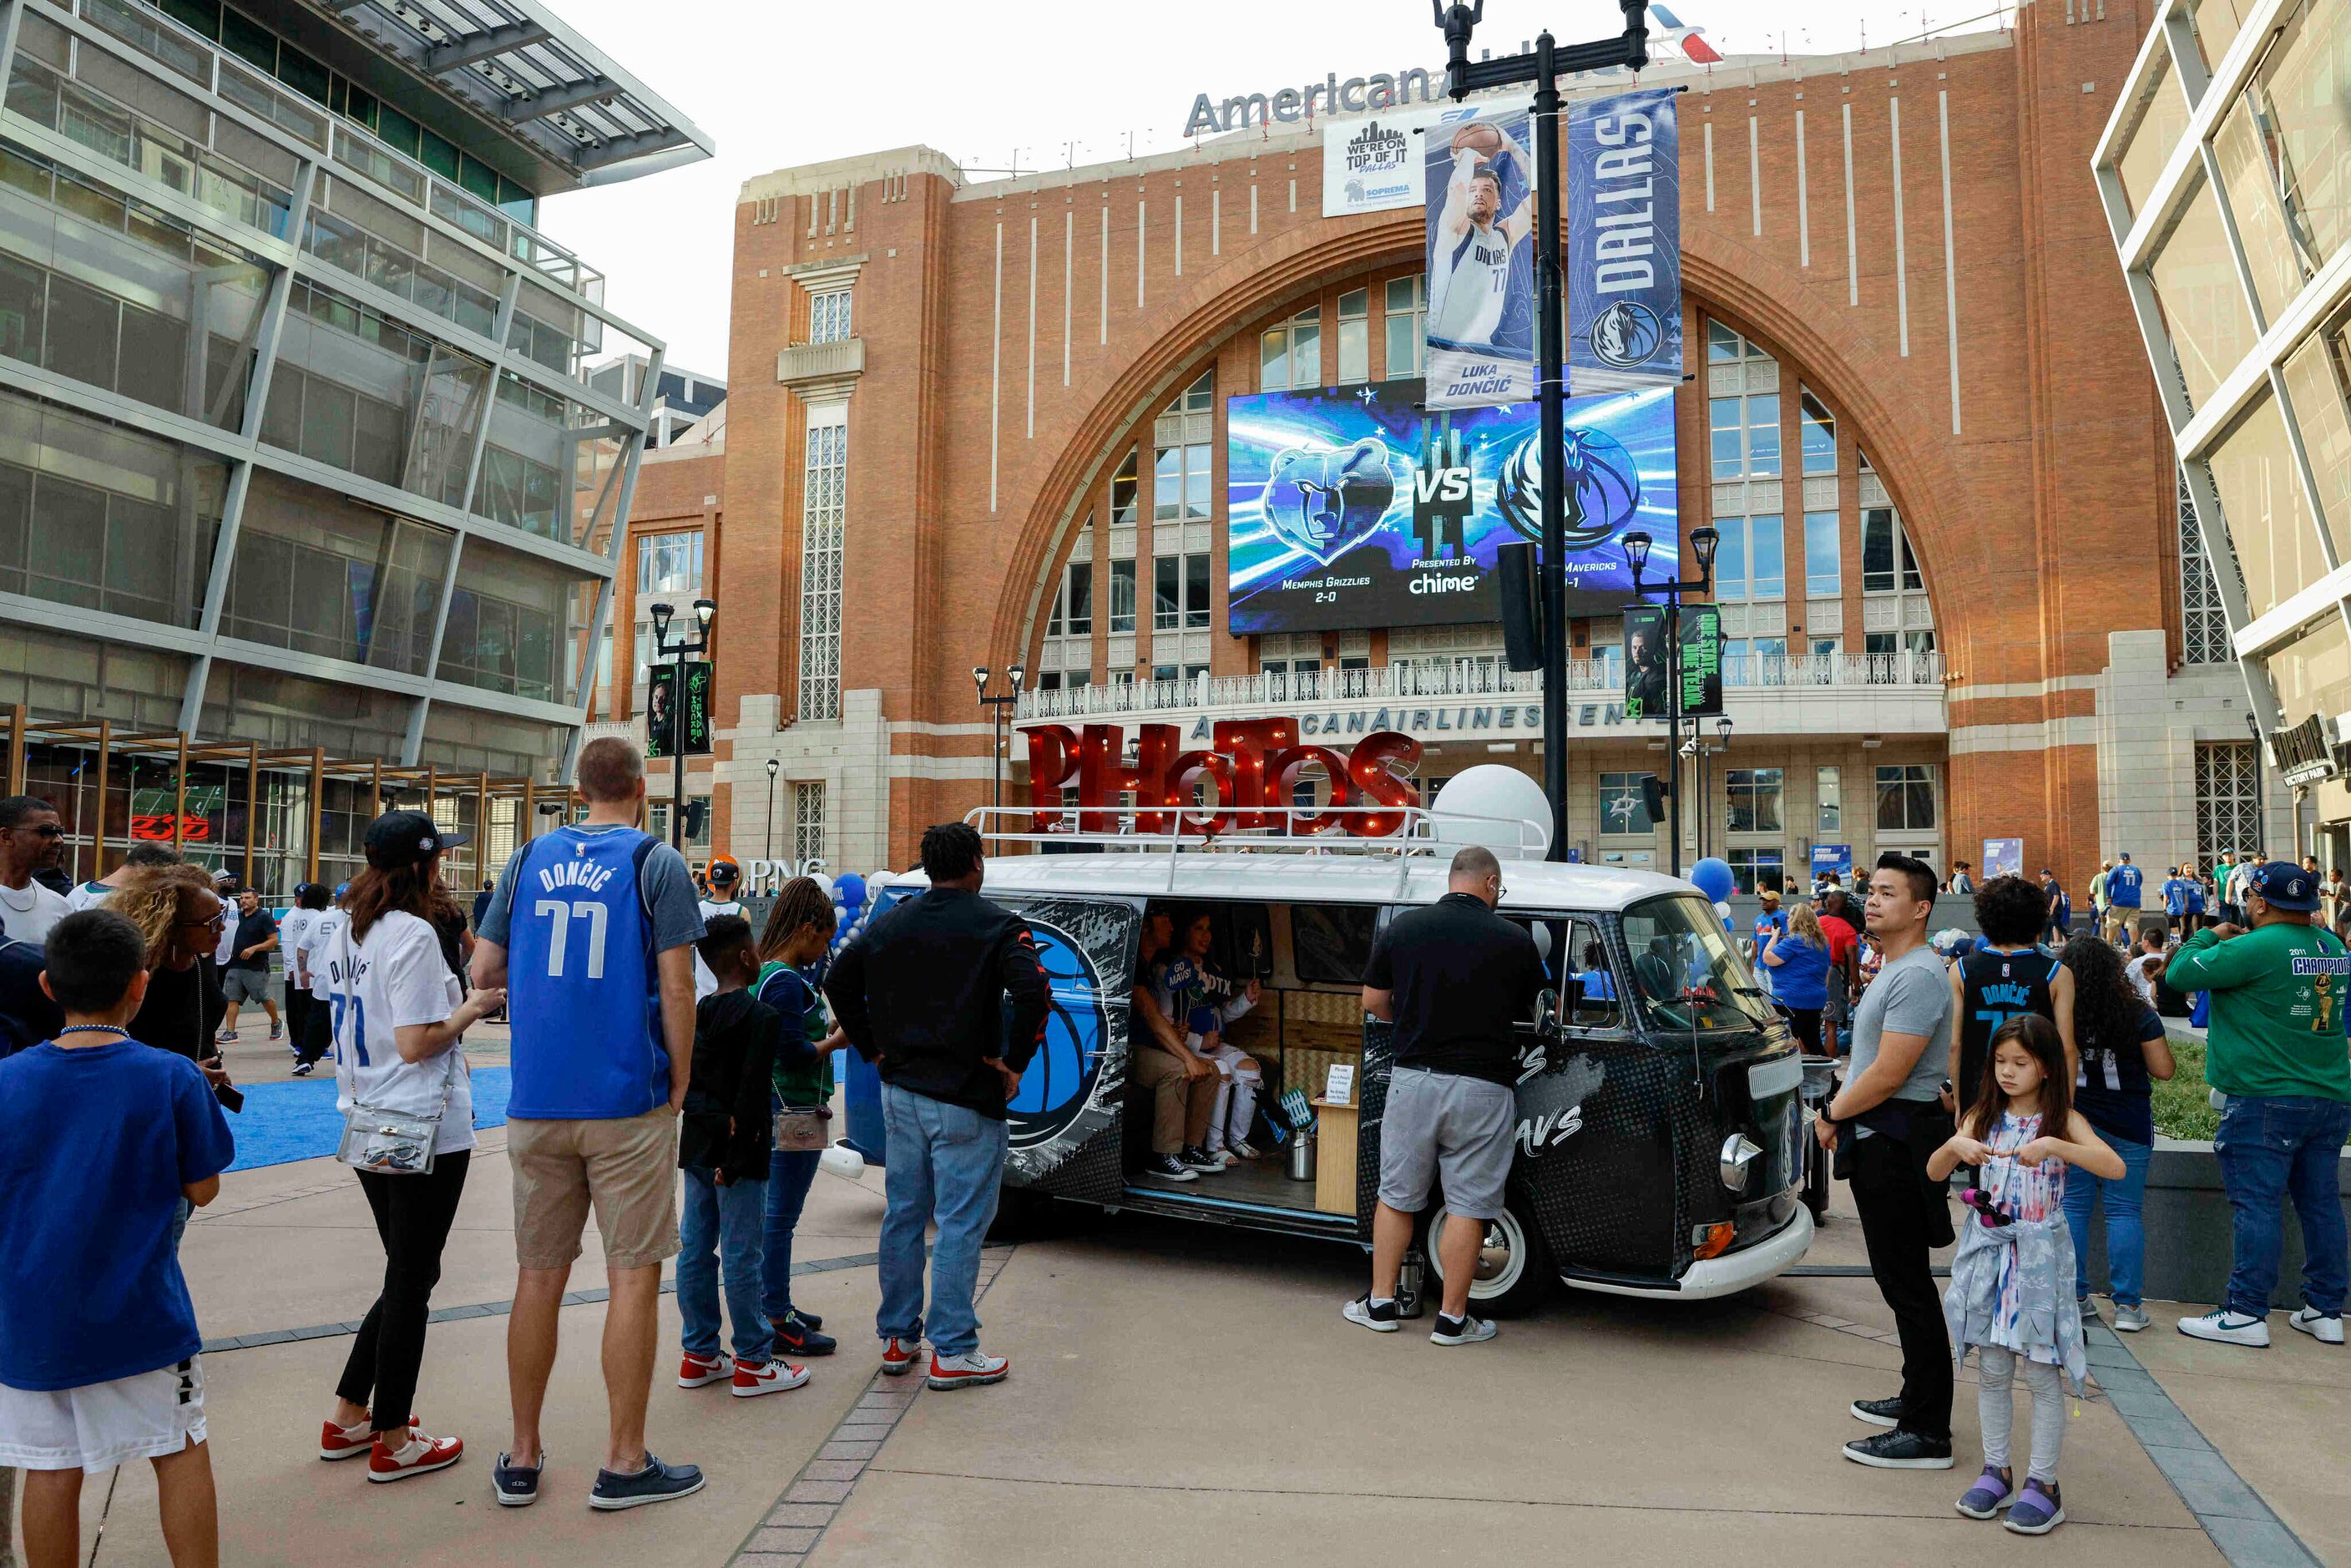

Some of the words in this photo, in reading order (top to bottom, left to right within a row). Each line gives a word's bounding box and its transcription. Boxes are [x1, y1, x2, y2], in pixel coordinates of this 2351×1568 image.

[1183, 66, 1429, 138] American
[1347, 141, 1383, 155] WE'RE
[1387, 138, 1406, 150] ON
[1347, 154, 1370, 170] TOP
[1376, 150, 1391, 163] OF
[1396, 148, 1408, 163] IT
[1359, 160, 1398, 173] DALLAS
[1366, 184, 1410, 196] SOPREMA
[1595, 113, 1654, 294] DALLAS
[1492, 267, 1507, 292] 77
[1461, 364, 1498, 378] LUKA
[1446, 375, 1513, 397] DONČIĆ
[1415, 466, 1472, 503] VS
[1412, 558, 1459, 569] PRESENTED
[1463, 556, 1476, 566] BY
[1565, 562, 1617, 573] MAVERICKS
[1282, 577, 1323, 591] MEMPHIS
[1325, 574, 1370, 589] GRIZZLIES
[1409, 573, 1476, 595] chime
[1315, 591, 1337, 604] 2-0
[1701, 614, 1716, 637] ONE
[2283, 770, 2310, 787] VICTORY
[2308, 766, 2327, 780] PARK
[538, 857, 618, 893] DONČIĆ
[535, 900, 608, 979] 77
[1169, 968, 1191, 987] MAVS!
[1174, 962, 1185, 973] GO
[330, 992, 370, 1067] 77
[1514, 1105, 1583, 1158] AVS
